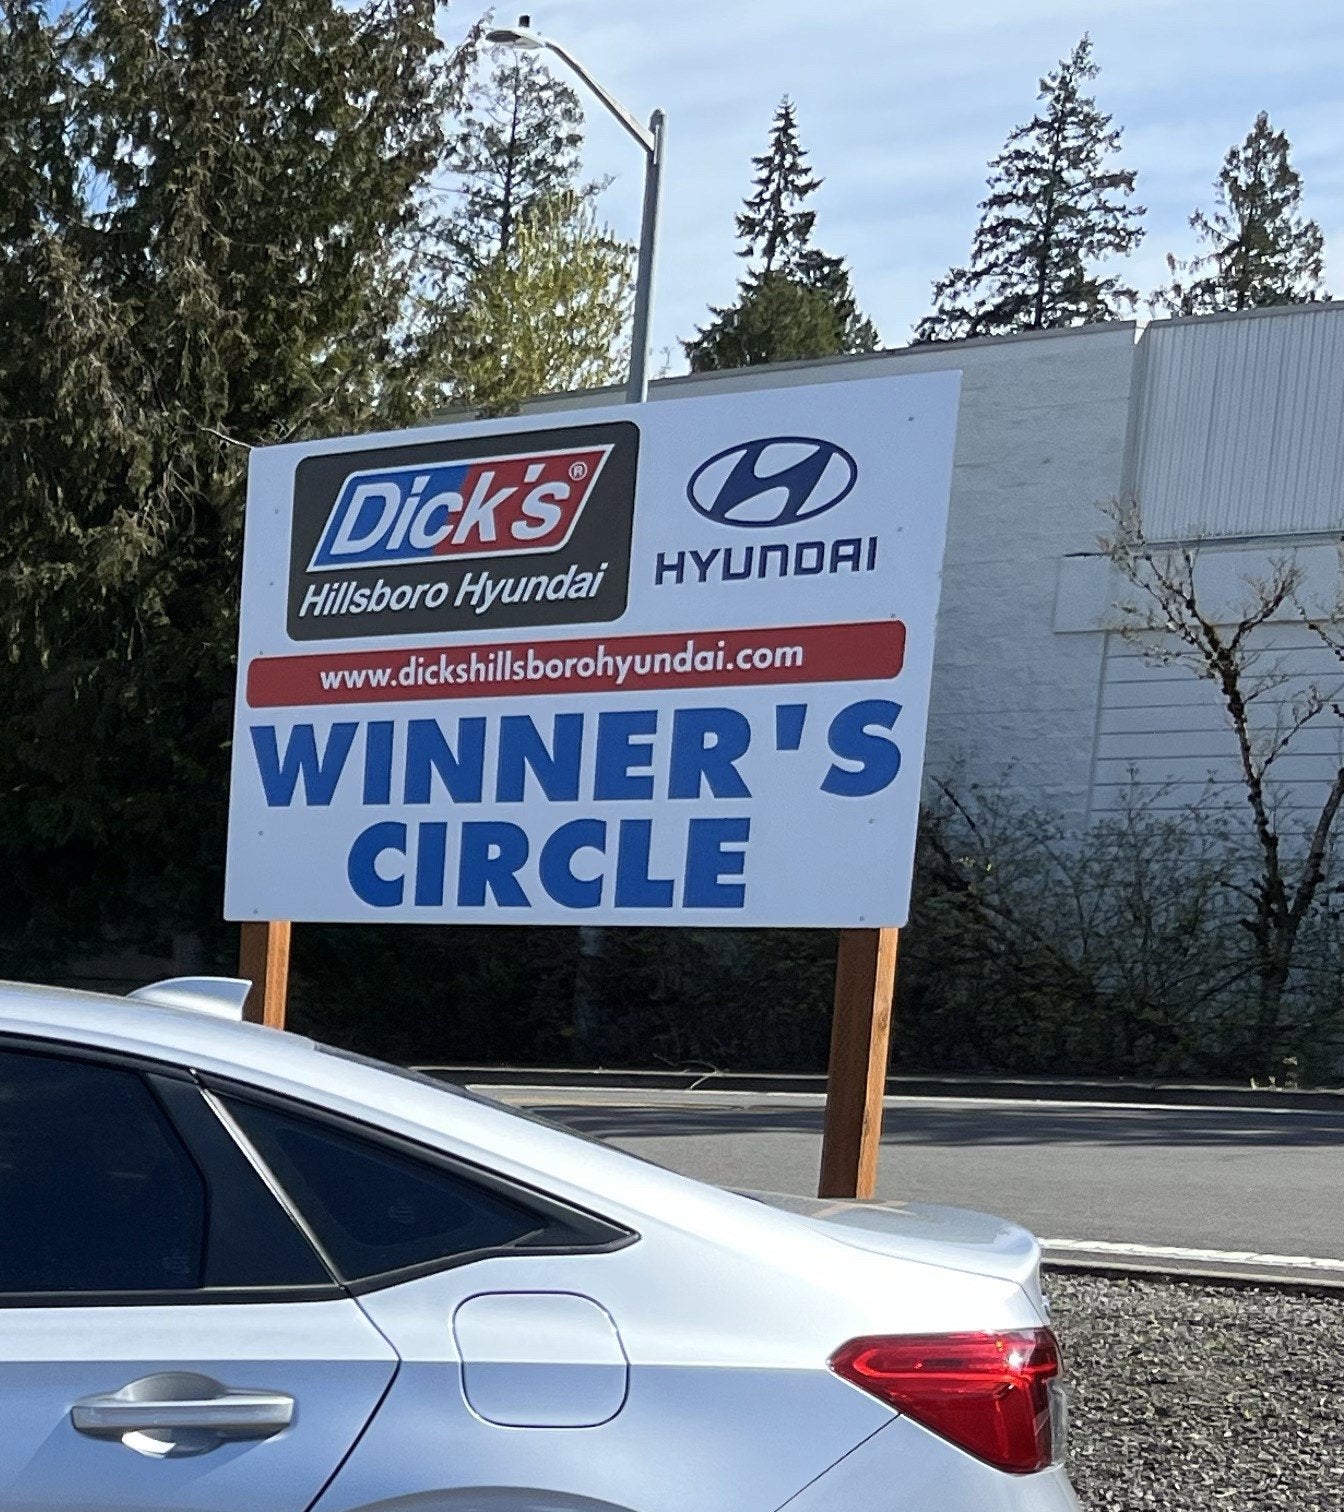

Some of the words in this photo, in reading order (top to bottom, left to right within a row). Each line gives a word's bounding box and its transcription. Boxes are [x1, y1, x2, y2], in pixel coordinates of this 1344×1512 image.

[330, 463, 571, 555] Dick's
[298, 577, 448, 618] Hillsboro
[454, 561, 609, 615] Hyundai
[655, 536, 879, 586] HYUNDAI
[320, 640, 804, 690] www.dickshillsborohyundai.com
[249, 699, 903, 807] WINNER'S
[347, 817, 751, 908] CIRCLE
